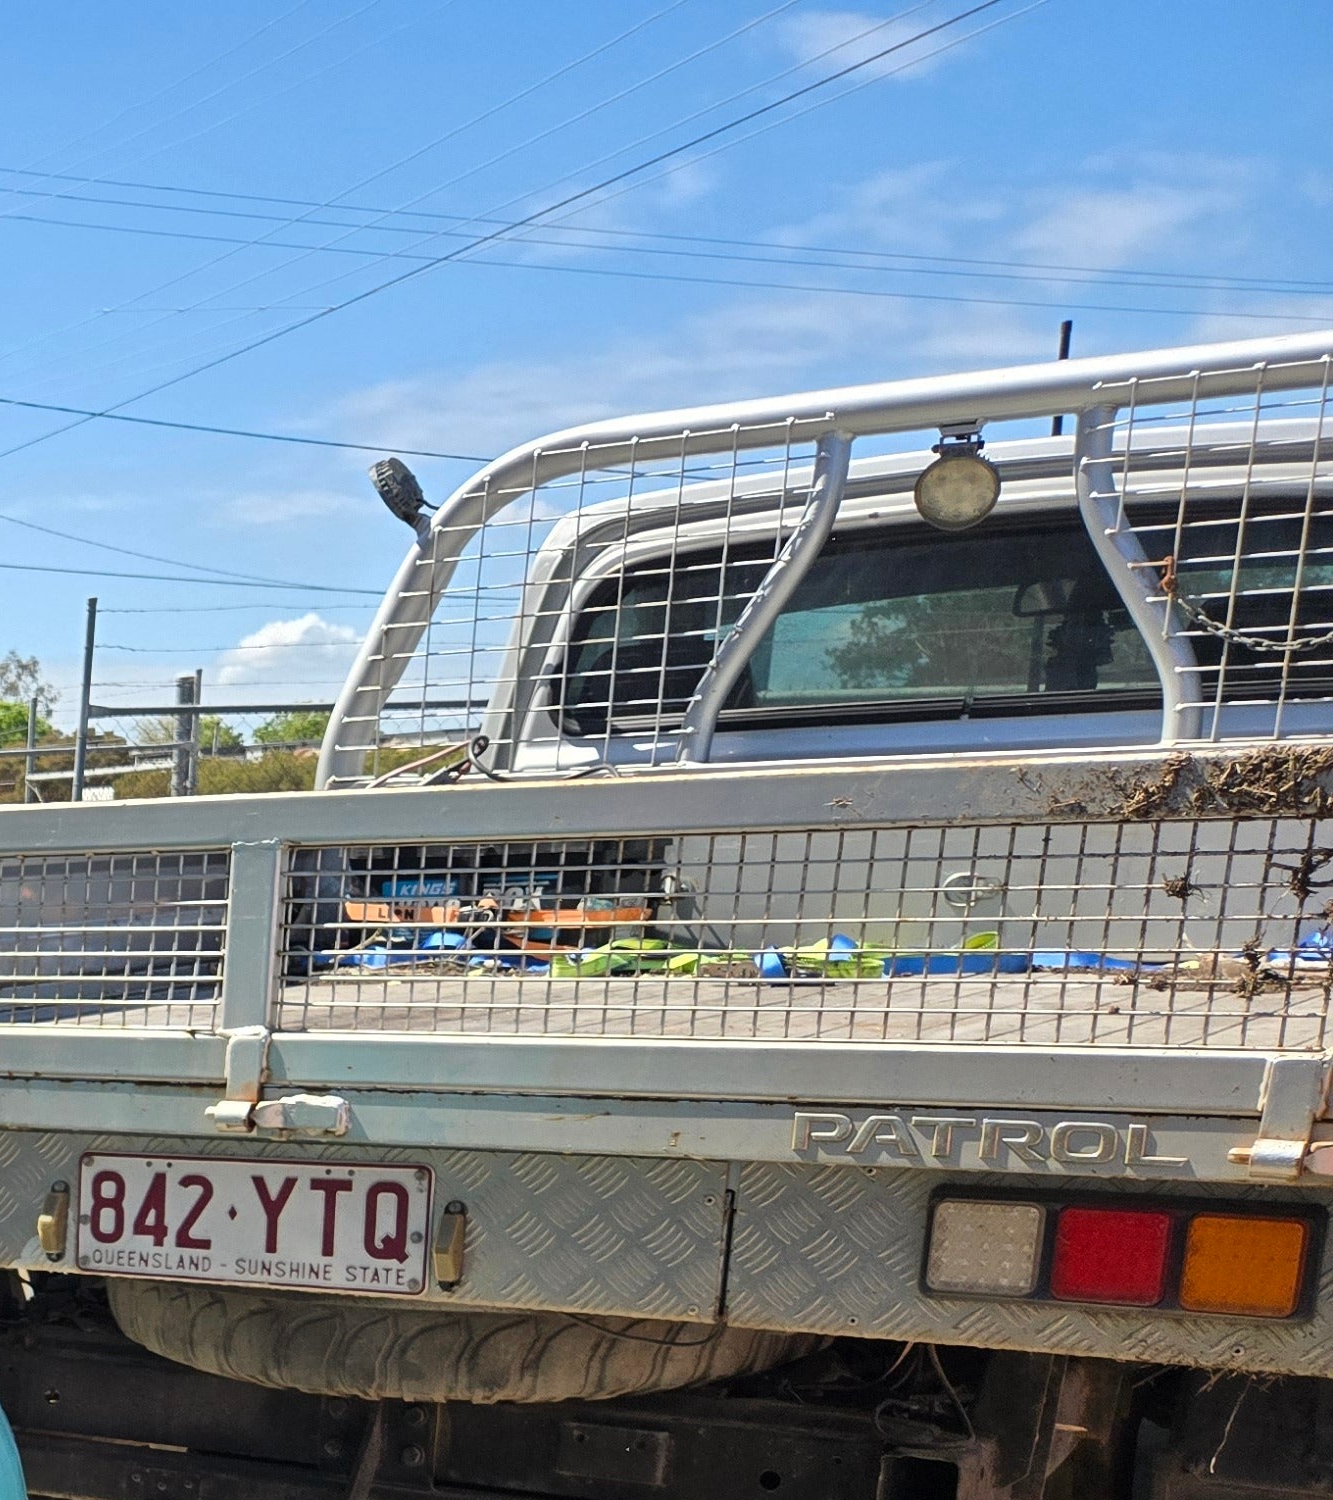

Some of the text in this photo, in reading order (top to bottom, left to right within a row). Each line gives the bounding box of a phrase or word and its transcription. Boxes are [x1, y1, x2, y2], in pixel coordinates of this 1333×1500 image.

[400, 882, 457, 897] KINGS
[790, 1111, 1189, 1167] PATROL
[91, 1249, 212, 1272] QUEENSLAND
[235, 1258, 333, 1282] SUNSHINE
[345, 1266, 407, 1287] STATE
